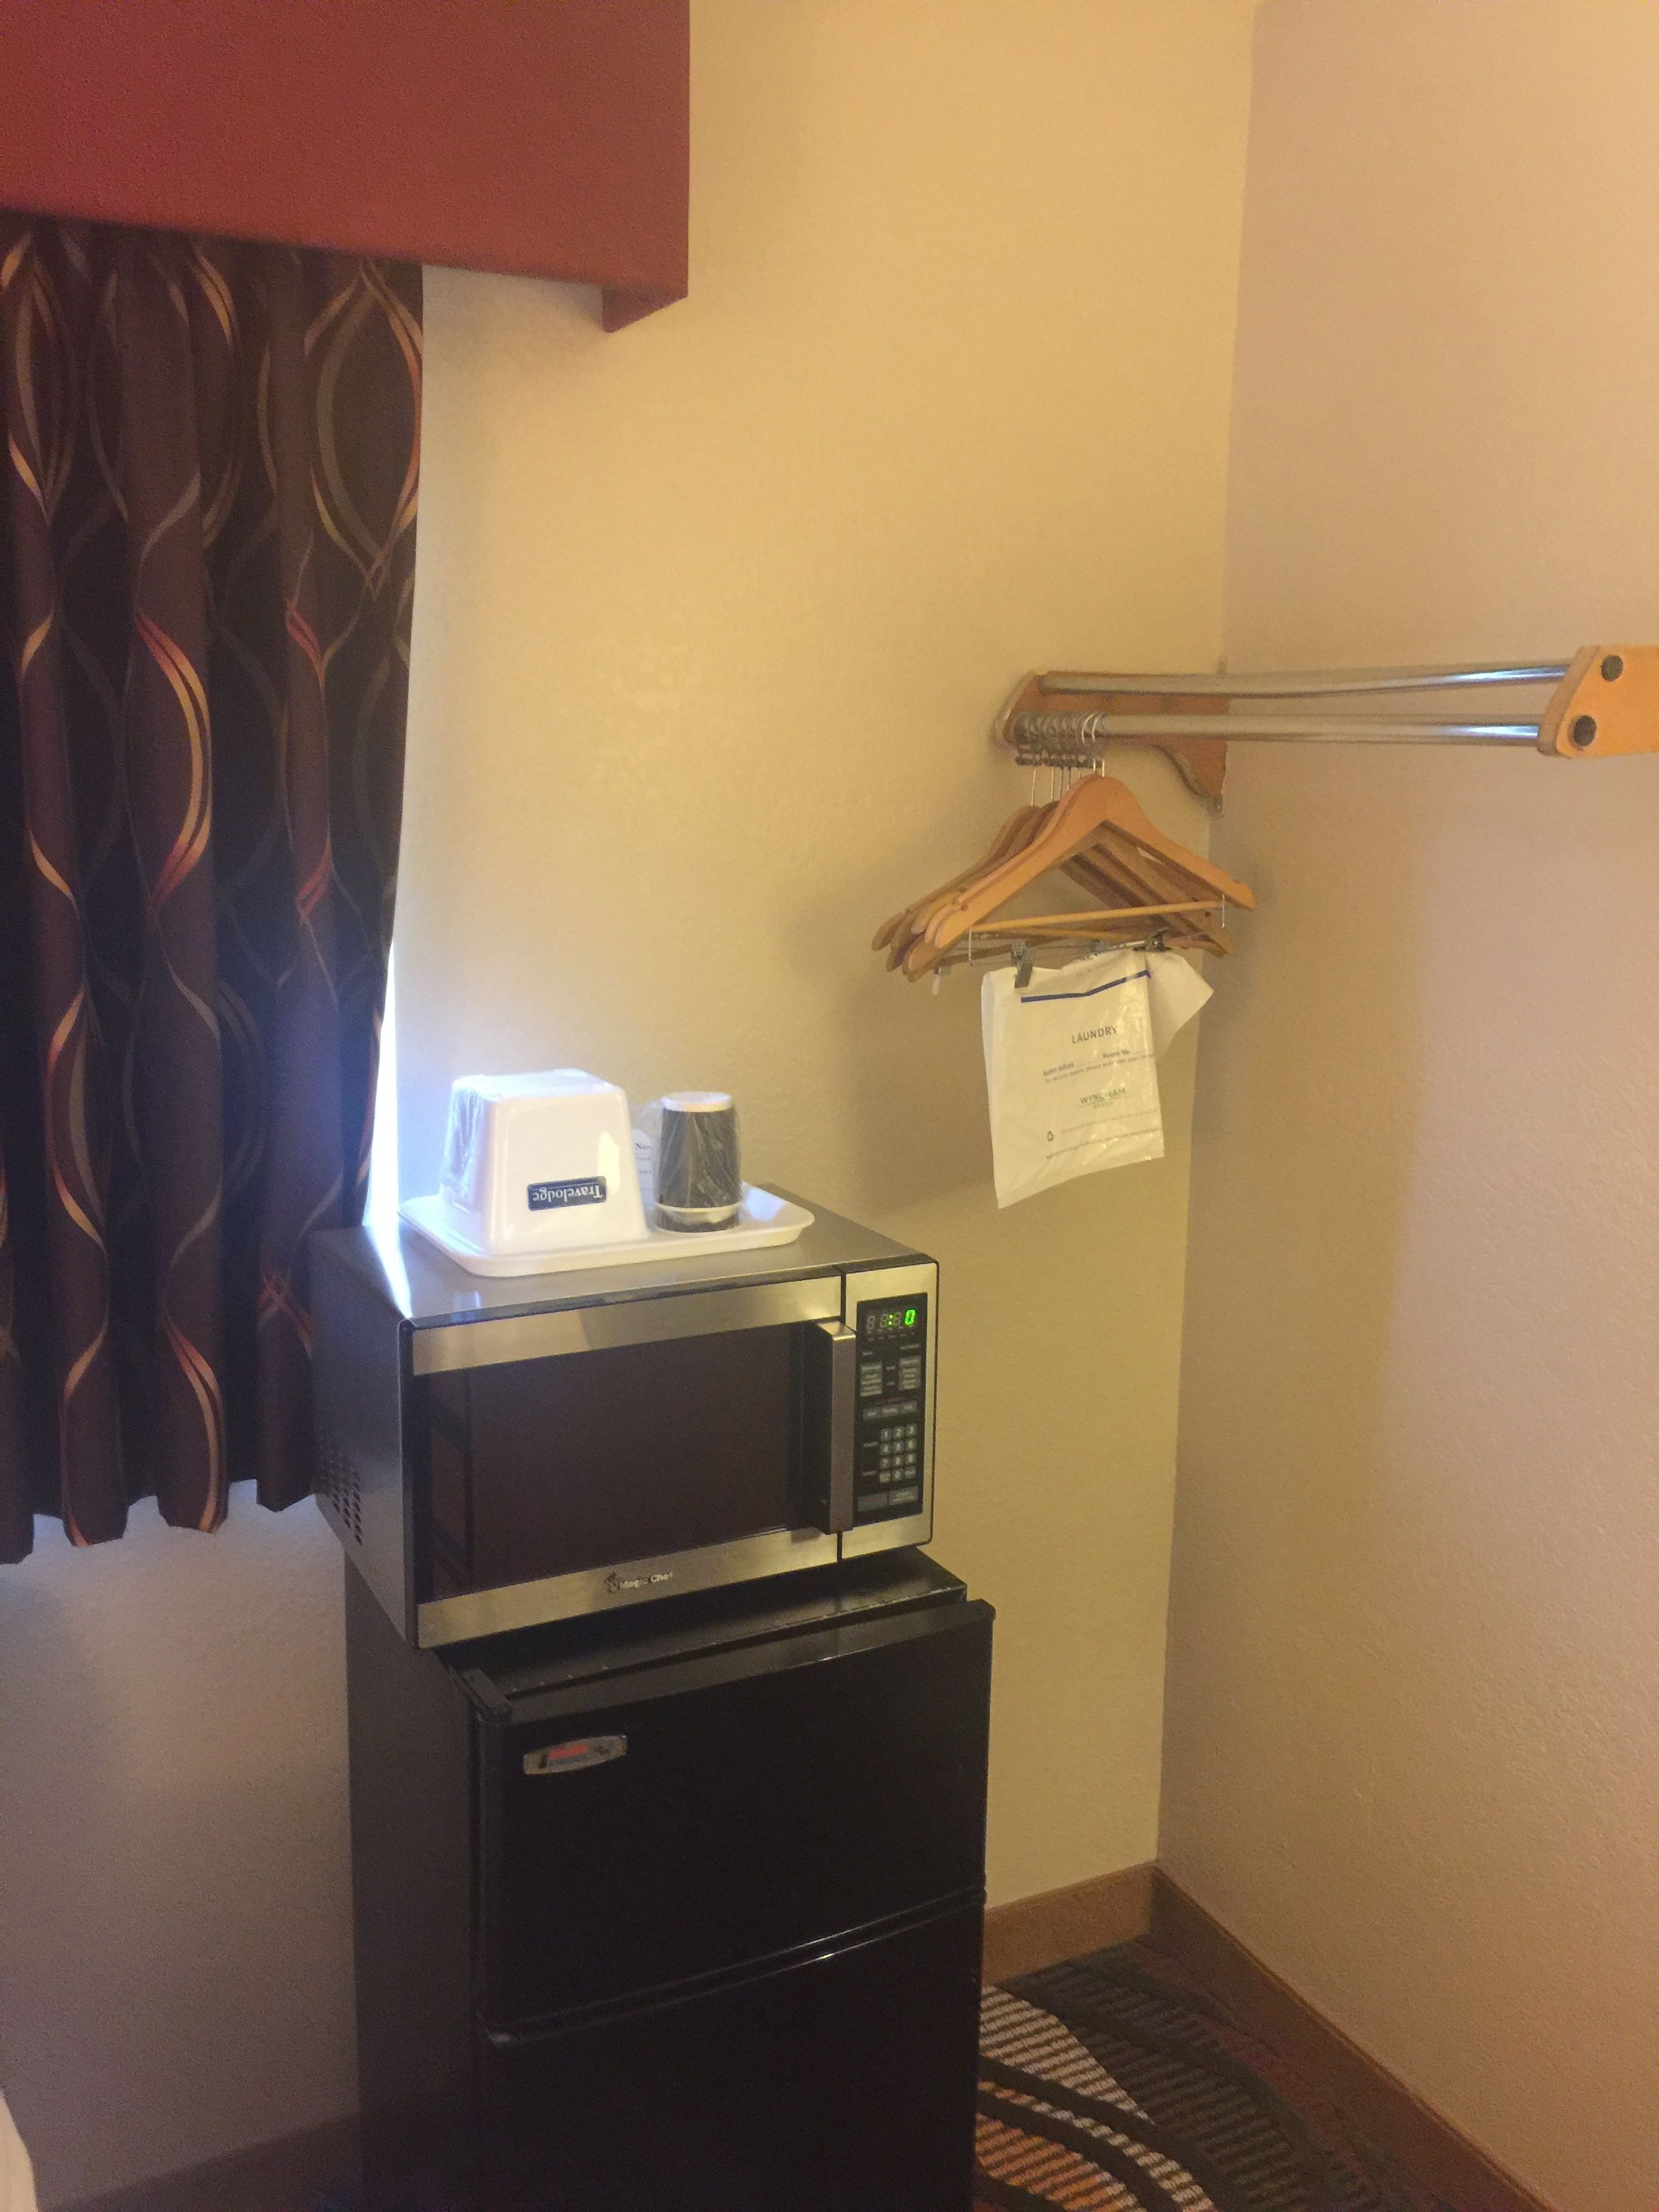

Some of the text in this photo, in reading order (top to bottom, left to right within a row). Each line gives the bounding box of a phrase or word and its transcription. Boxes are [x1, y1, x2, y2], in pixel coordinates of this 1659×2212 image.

[1071, 1025, 1118, 1044] LAUNDRY
[1080, 1087, 1126, 1105] WYNDHAM
[532, 1185, 604, 1203] Travelodge
[650, 1570, 673, 1583] Chef
